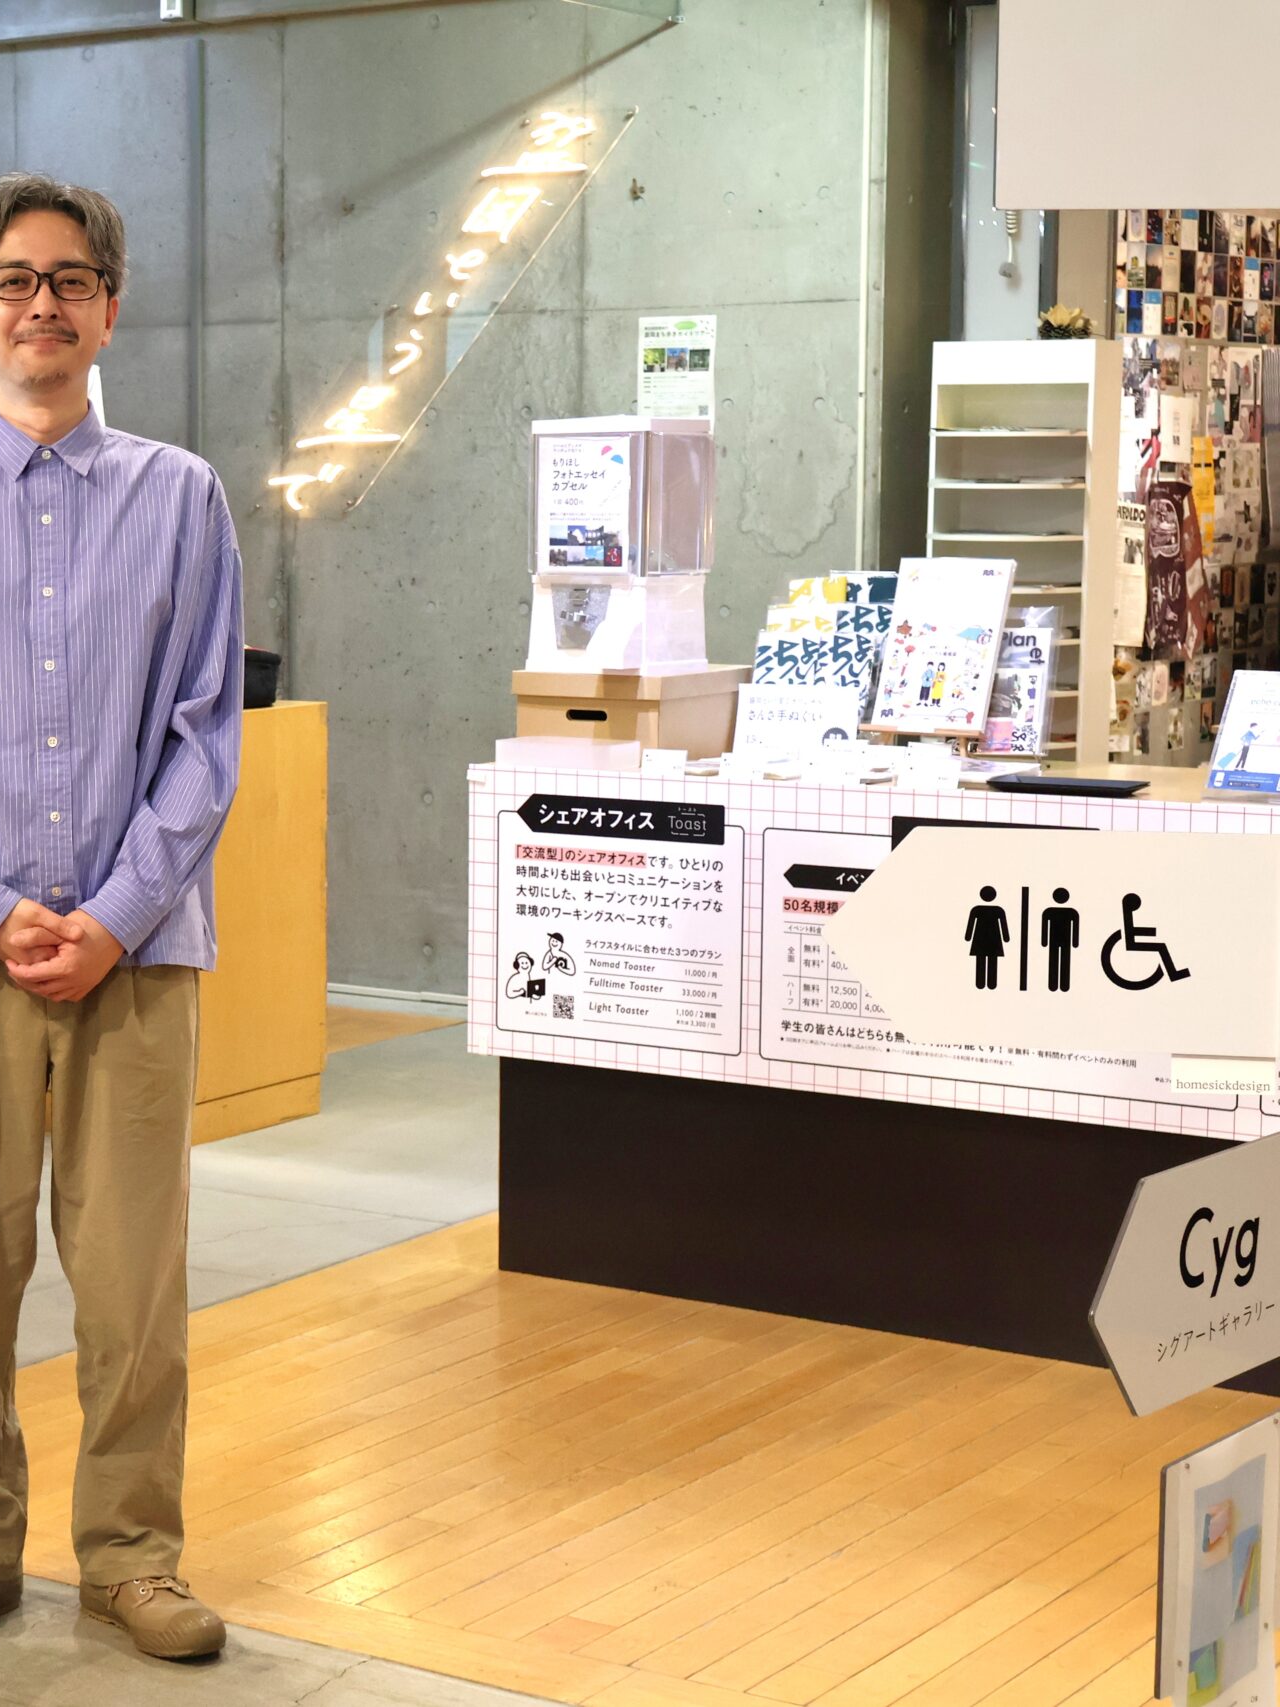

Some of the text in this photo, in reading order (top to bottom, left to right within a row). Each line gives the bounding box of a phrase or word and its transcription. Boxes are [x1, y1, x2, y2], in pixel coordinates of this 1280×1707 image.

[553, 458, 580, 468] もりほし
[553, 470, 606, 480] フォトエッセイ
[539, 803, 655, 831] シェアオフィス
[668, 815, 706, 831] Toast
[516, 865, 724, 893] 時間よりも出会いとコミュニケーションを
[516, 885, 724, 913] 大切にした、オープンでクリエイティブな
[783, 898, 839, 914] 50名規模
[516, 903, 673, 929] 環境のワーキングスペースです。
[585, 939, 723, 960] ライフスタイルに合わせた3つのプラン
[803, 944, 820, 955] 無料
[589, 958, 655, 972] Nomad Toaster
[589, 977, 663, 993] Fulltime Toaster
[803, 983, 820, 993] 無料
[830, 985, 858, 996] 12,500
[589, 1002, 649, 1016] Light Toaster
[830, 1000, 858, 1011] 20,000
[1175, 1079, 1271, 1094] homesickdesign
[1179, 1206, 1260, 1298] Cyg
[1157, 1300, 1276, 1363] シグアートギャラリー
